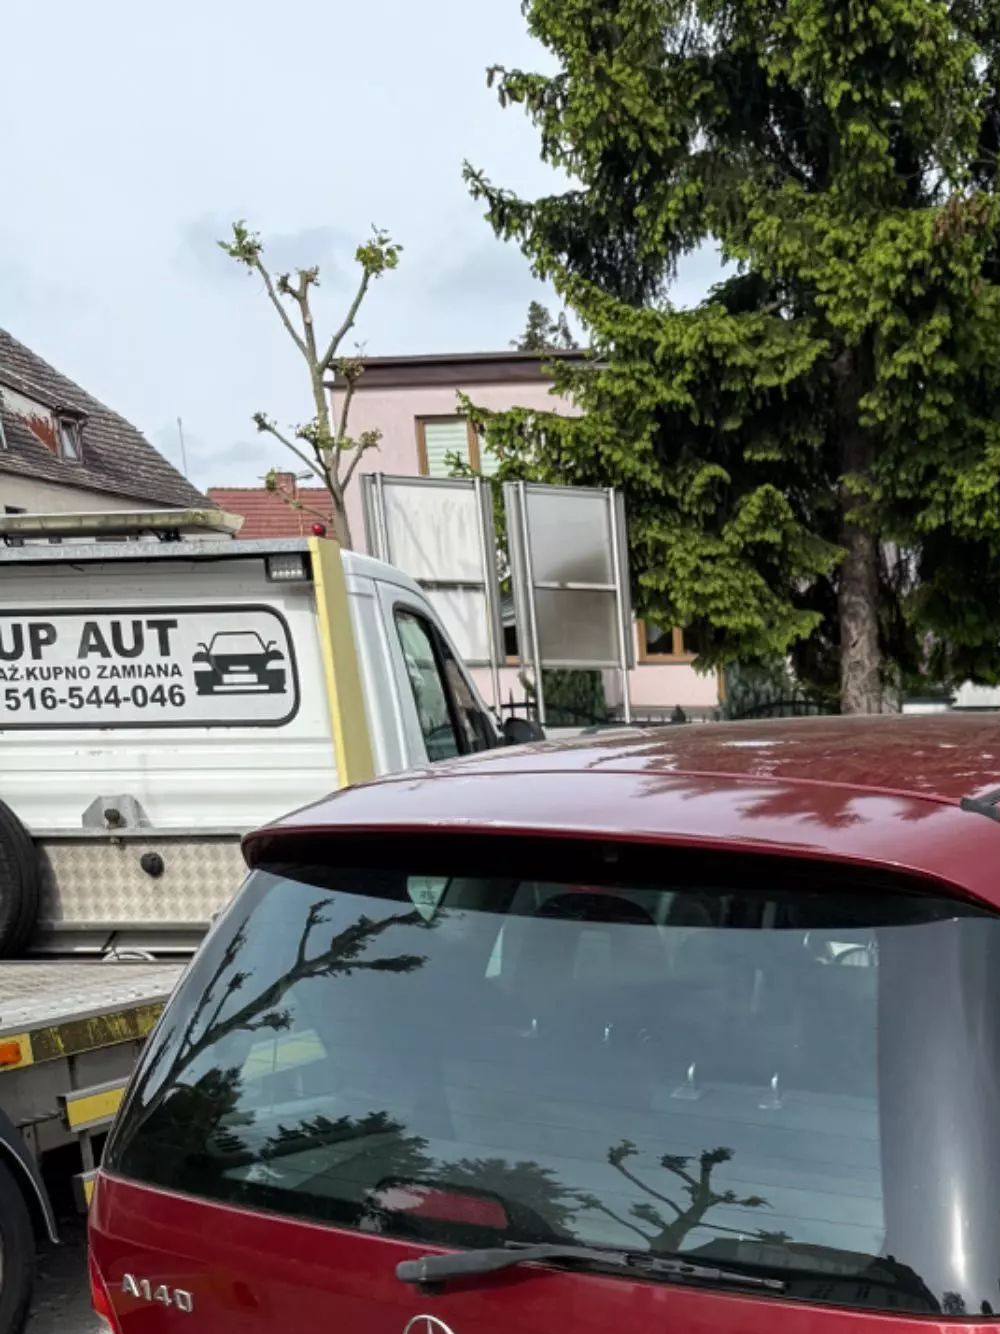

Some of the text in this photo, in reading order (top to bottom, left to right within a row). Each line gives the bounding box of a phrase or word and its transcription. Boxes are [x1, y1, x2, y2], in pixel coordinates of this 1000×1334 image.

[77, 619, 178, 660] AUT
[97, 663, 183, 680] ZAMIANA
[5, 684, 186, 711] 516-544-046
[122, 1273, 194, 1313] A140
